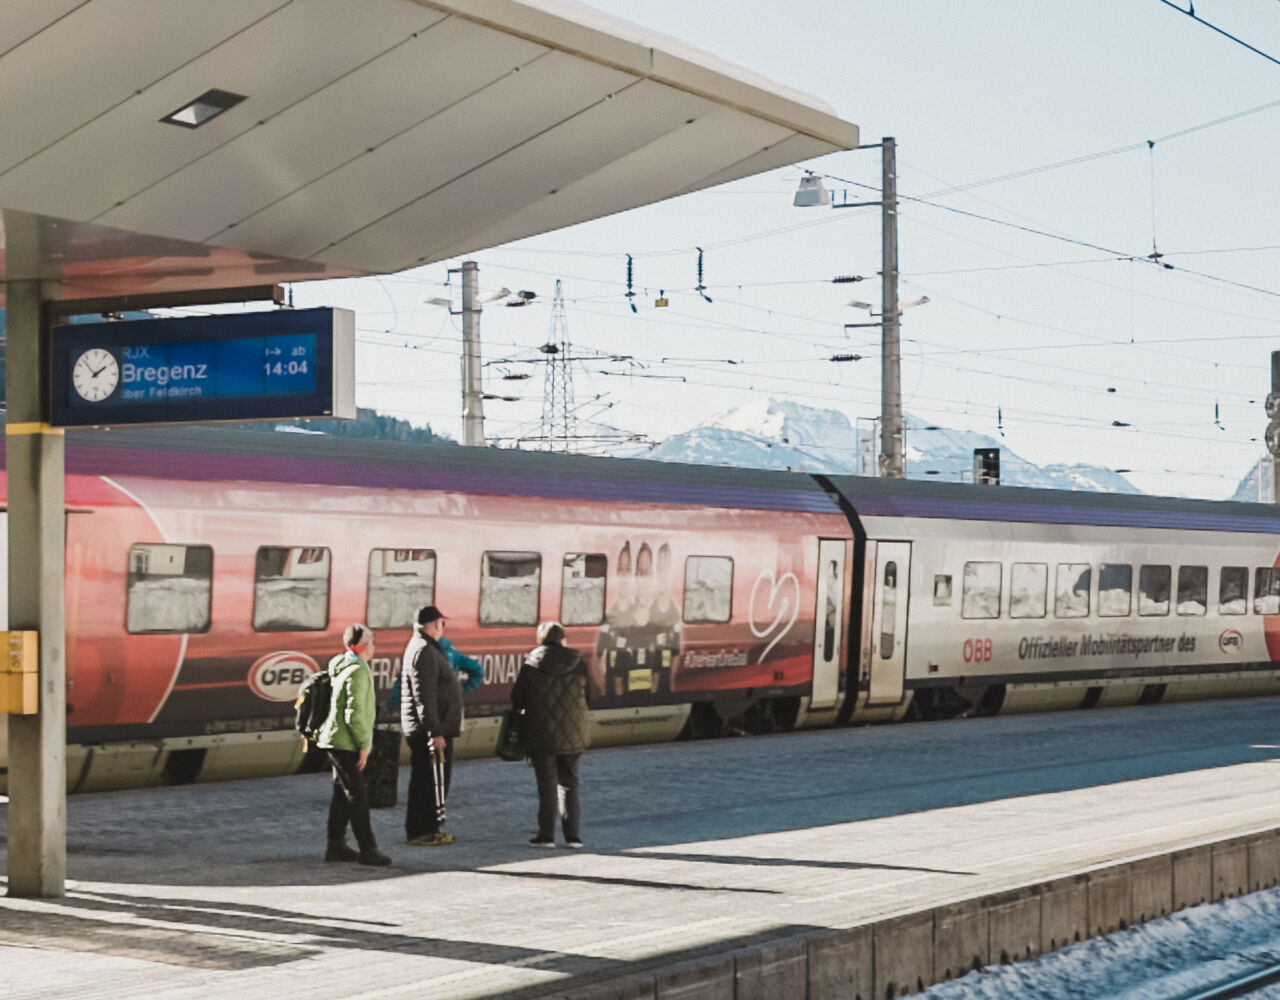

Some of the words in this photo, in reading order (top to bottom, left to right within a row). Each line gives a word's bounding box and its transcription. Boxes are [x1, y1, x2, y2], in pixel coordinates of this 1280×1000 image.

[122, 363, 208, 386] Bregenz
[264, 360, 308, 376] 14:04
[149, 386, 202, 398] Feldkirch
[1018, 635, 1079, 660] Offizieller
[1177, 632, 1197, 653] des
